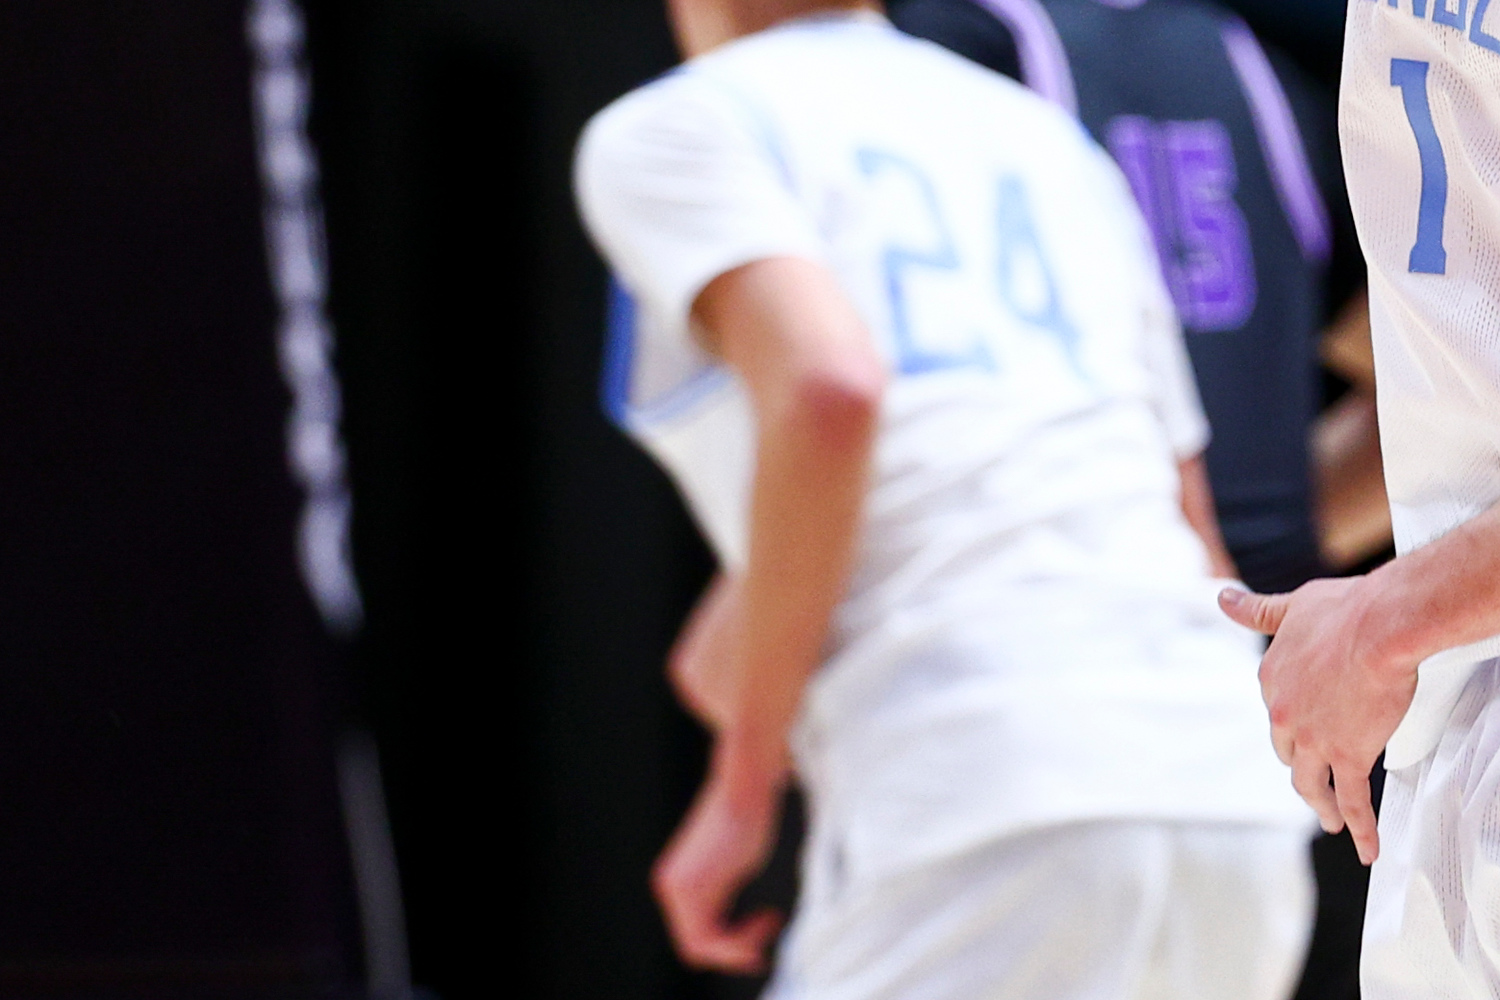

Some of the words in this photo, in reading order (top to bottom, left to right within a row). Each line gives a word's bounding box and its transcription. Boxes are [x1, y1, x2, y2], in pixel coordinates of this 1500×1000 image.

[854, 147, 1098, 378] 24
[1107, 113, 1257, 333] 15
[1390, 57, 1448, 275] 1
